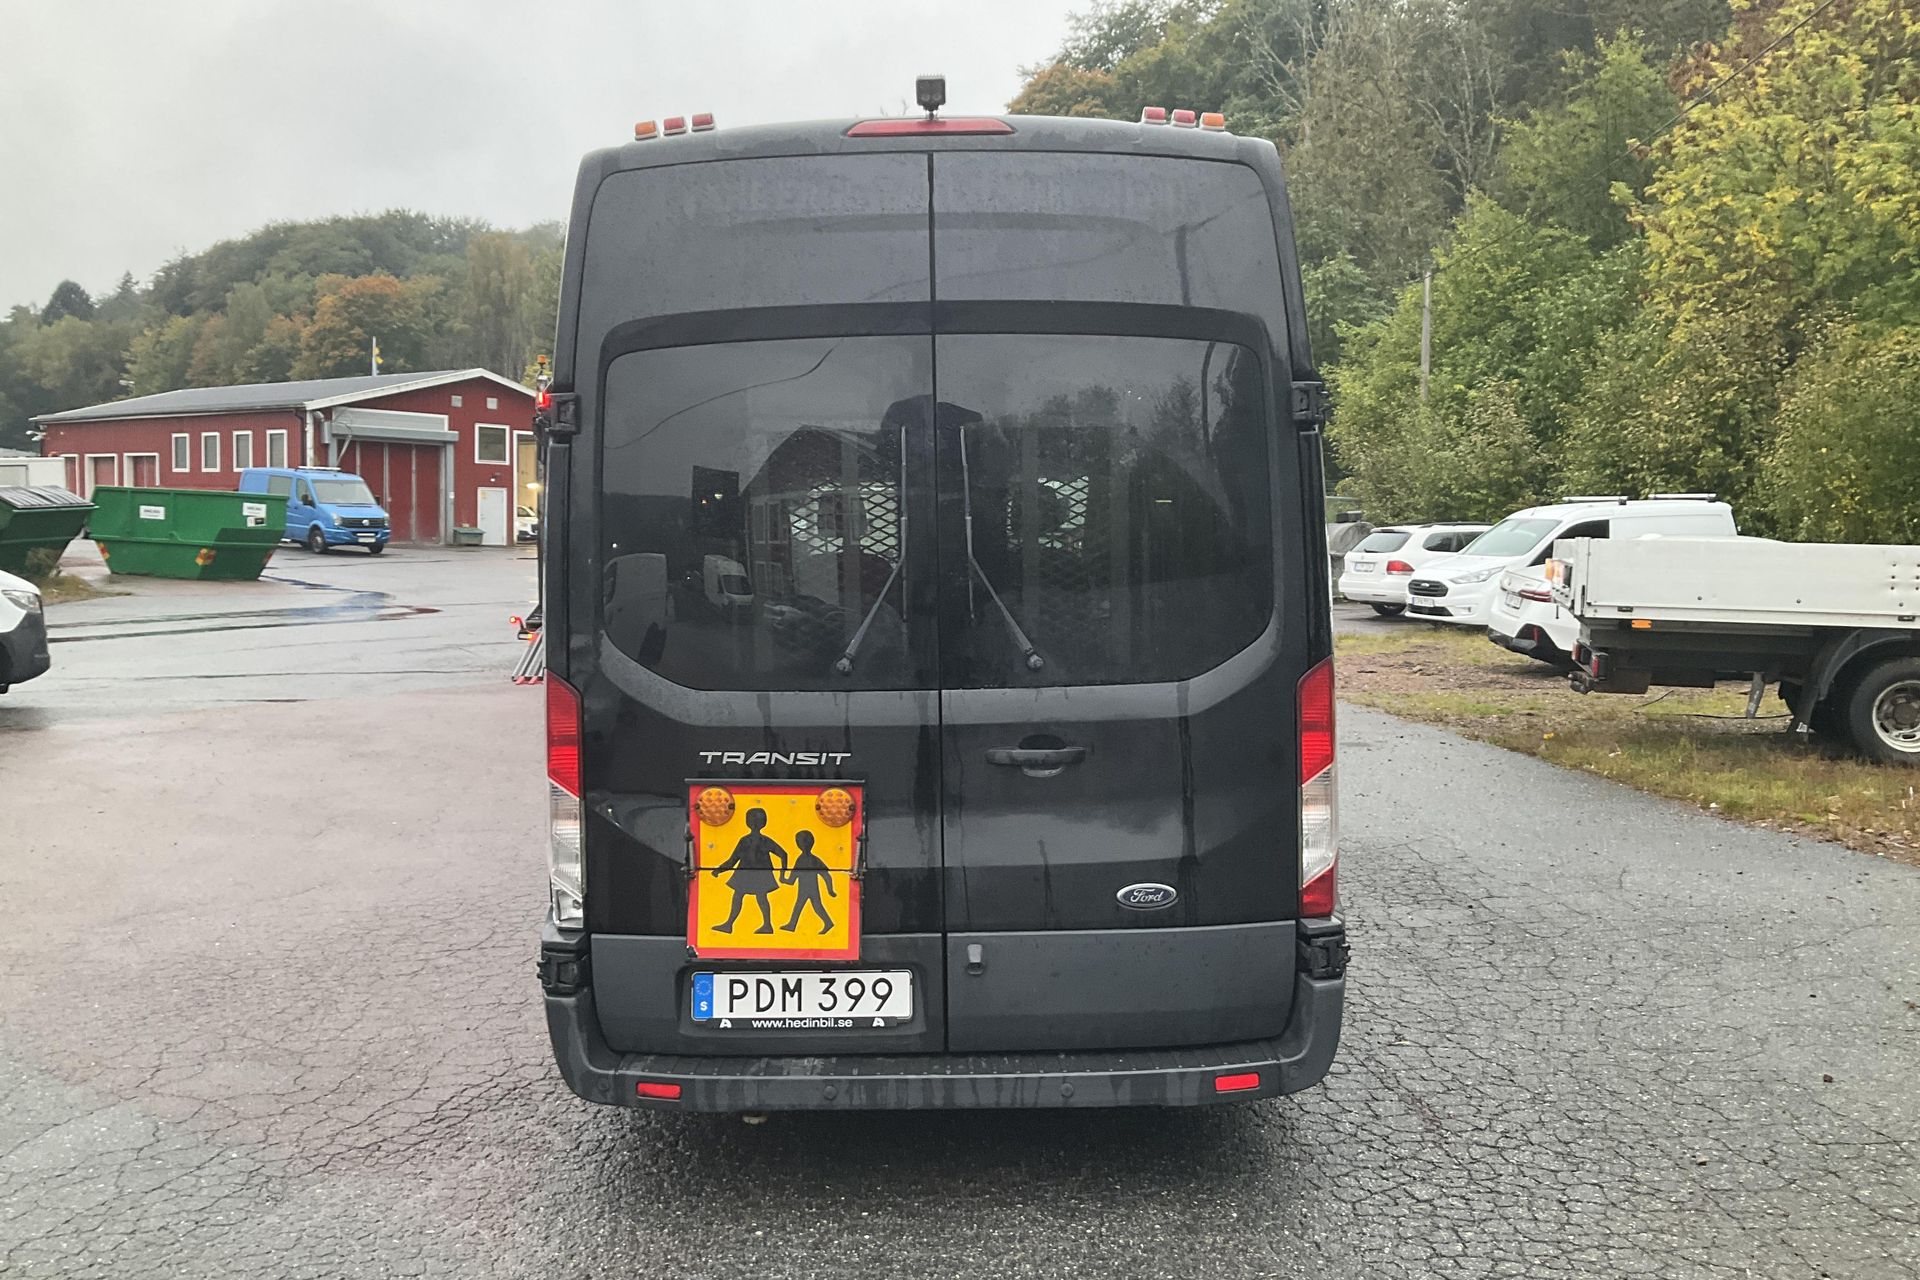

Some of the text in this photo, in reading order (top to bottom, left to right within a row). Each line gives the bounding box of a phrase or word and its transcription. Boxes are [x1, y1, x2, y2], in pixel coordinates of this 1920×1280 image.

[699, 751, 852, 766] TRANSIT
[1130, 888, 1164, 903] Ford
[728, 977, 894, 1013] PDM 399
[700, 1001, 708, 1011] S
[751, 1017, 854, 1029] www.hedinbil.se
